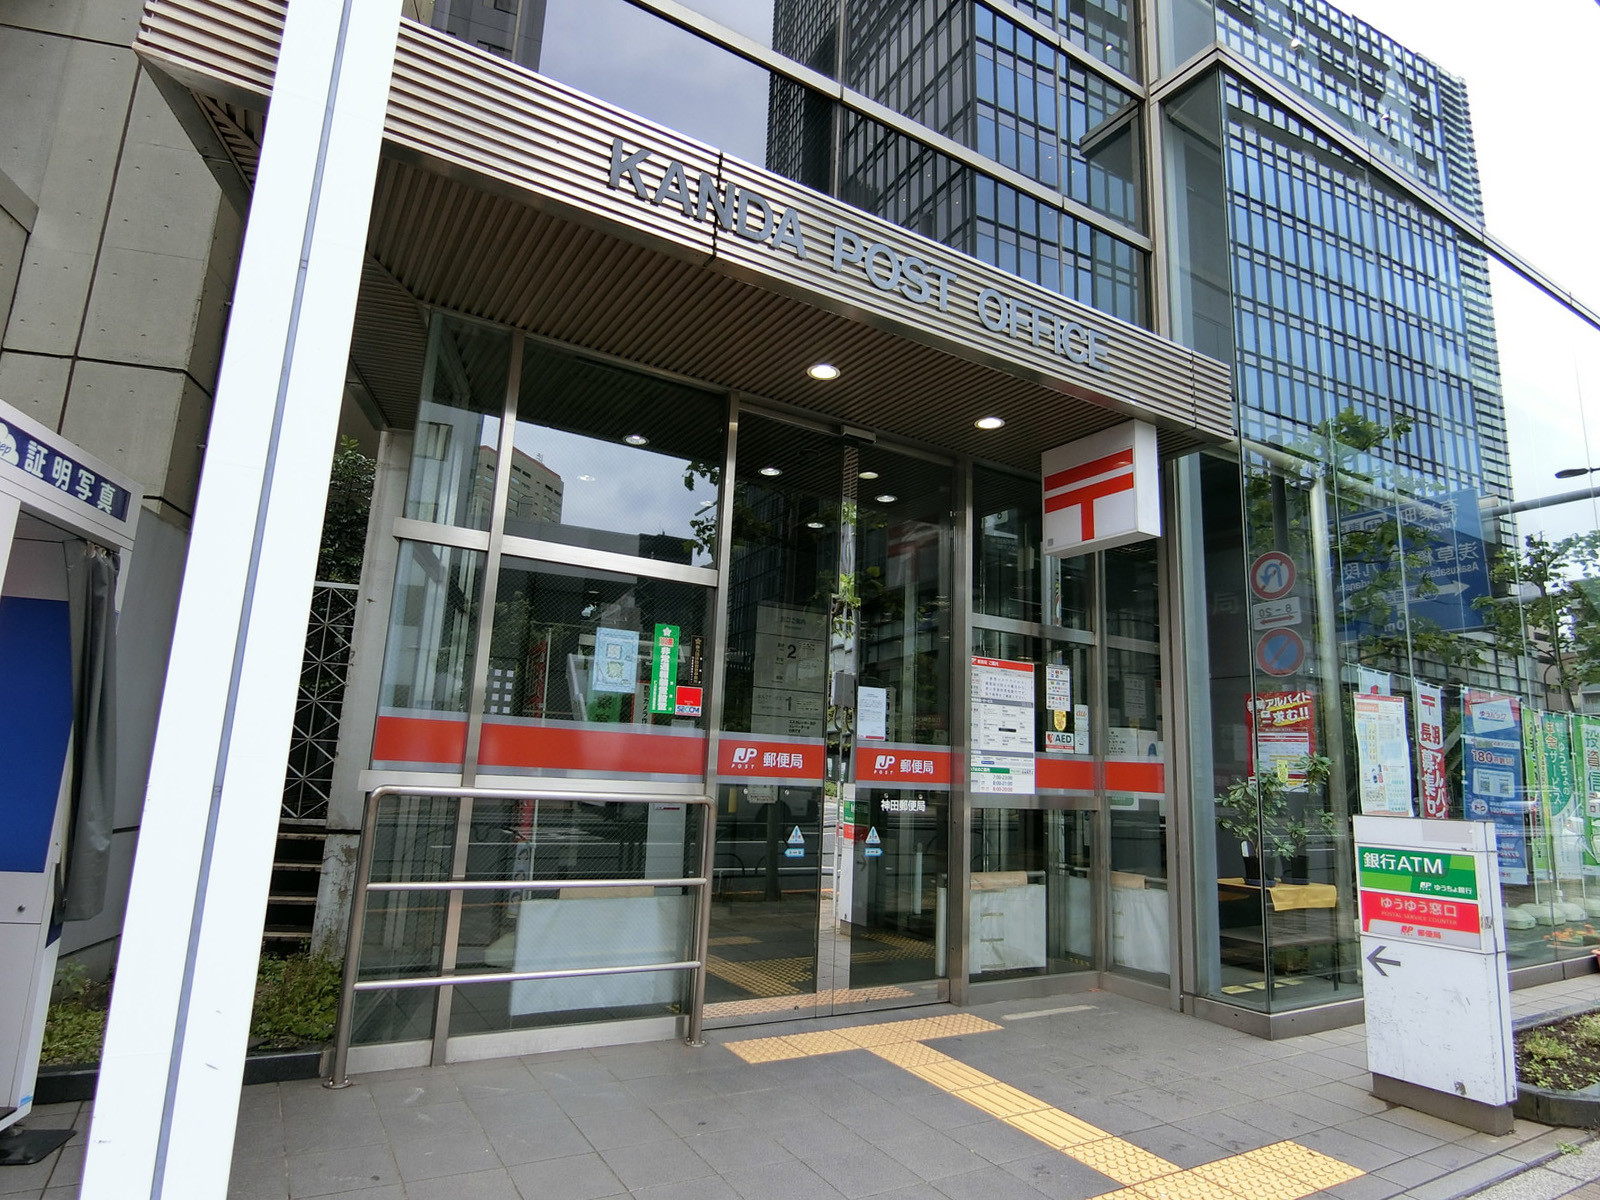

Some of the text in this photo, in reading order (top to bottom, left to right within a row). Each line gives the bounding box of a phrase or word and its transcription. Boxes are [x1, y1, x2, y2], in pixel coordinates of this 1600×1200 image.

[607, 136, 1111, 374] KANDA POST OFFICE
[24, 439, 116, 515] 証明写真
[787, 644, 797, 659] 2
[1265, 692, 1312, 709] アルバイト
[676, 705, 701, 714] SECOM
[1054, 734, 1073, 744] AED
[763, 752, 803, 769] 郵便局
[900, 759, 934, 775] 郵便局
[880, 799, 926, 812] 神田郵便局
[1363, 852, 1443, 875] 銀行ATM
[1434, 884, 1473, 895] ゆうちょ銀行
[1380, 897, 1457, 917] ゆうゆう窓口
